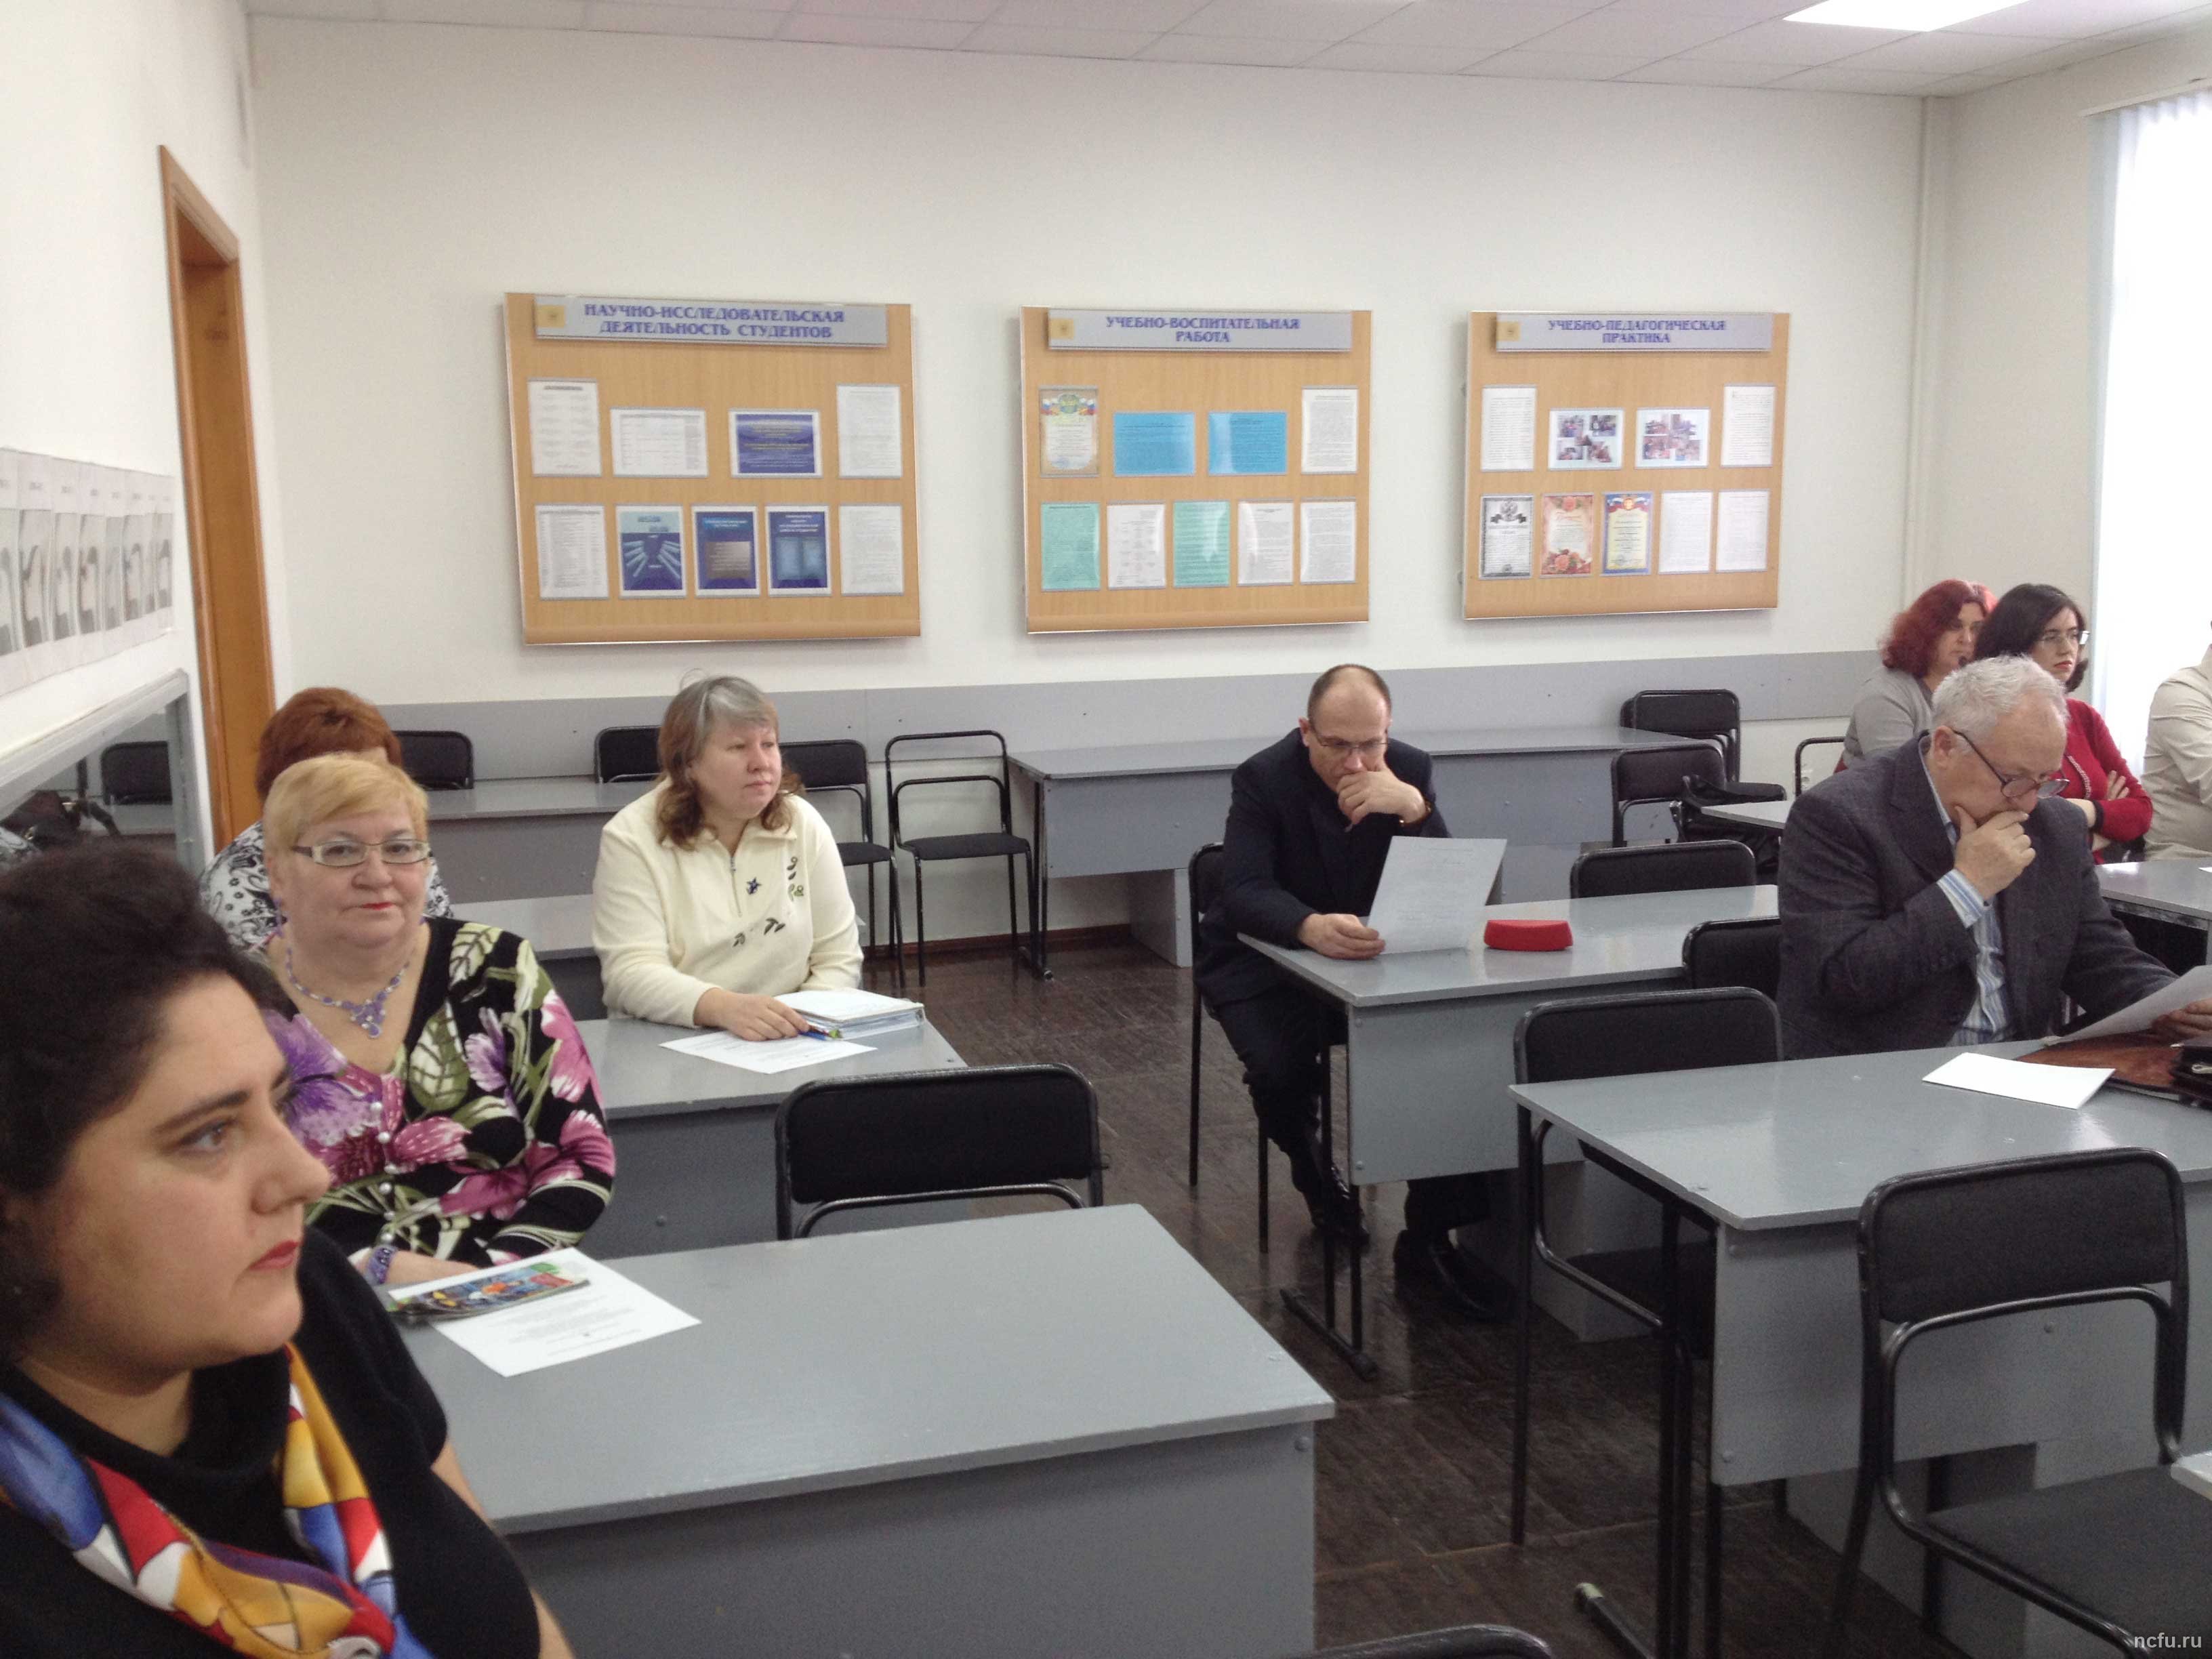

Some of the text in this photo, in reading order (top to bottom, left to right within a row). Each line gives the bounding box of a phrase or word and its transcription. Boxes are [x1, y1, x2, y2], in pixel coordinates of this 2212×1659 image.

[583, 303, 845, 323] НАУЧНО-ИССЛЕДОВАТЕЛЬСКАЯ
[599, 320, 832, 338] ДЕЯТЕЛЬНОСТЬ СТУДЕНТОВ
[1105, 316, 1300, 330] УЧЕБНО-ВОСПИТАТЕЛЬНАЯ
[1548, 320, 1726, 331] УЧЕБНО-ПЕДАГОГИЧЕСКАЯ
[1175, 330, 1231, 343] РАБОТА
[1602, 332, 1671, 344] ПРАКТИКА
